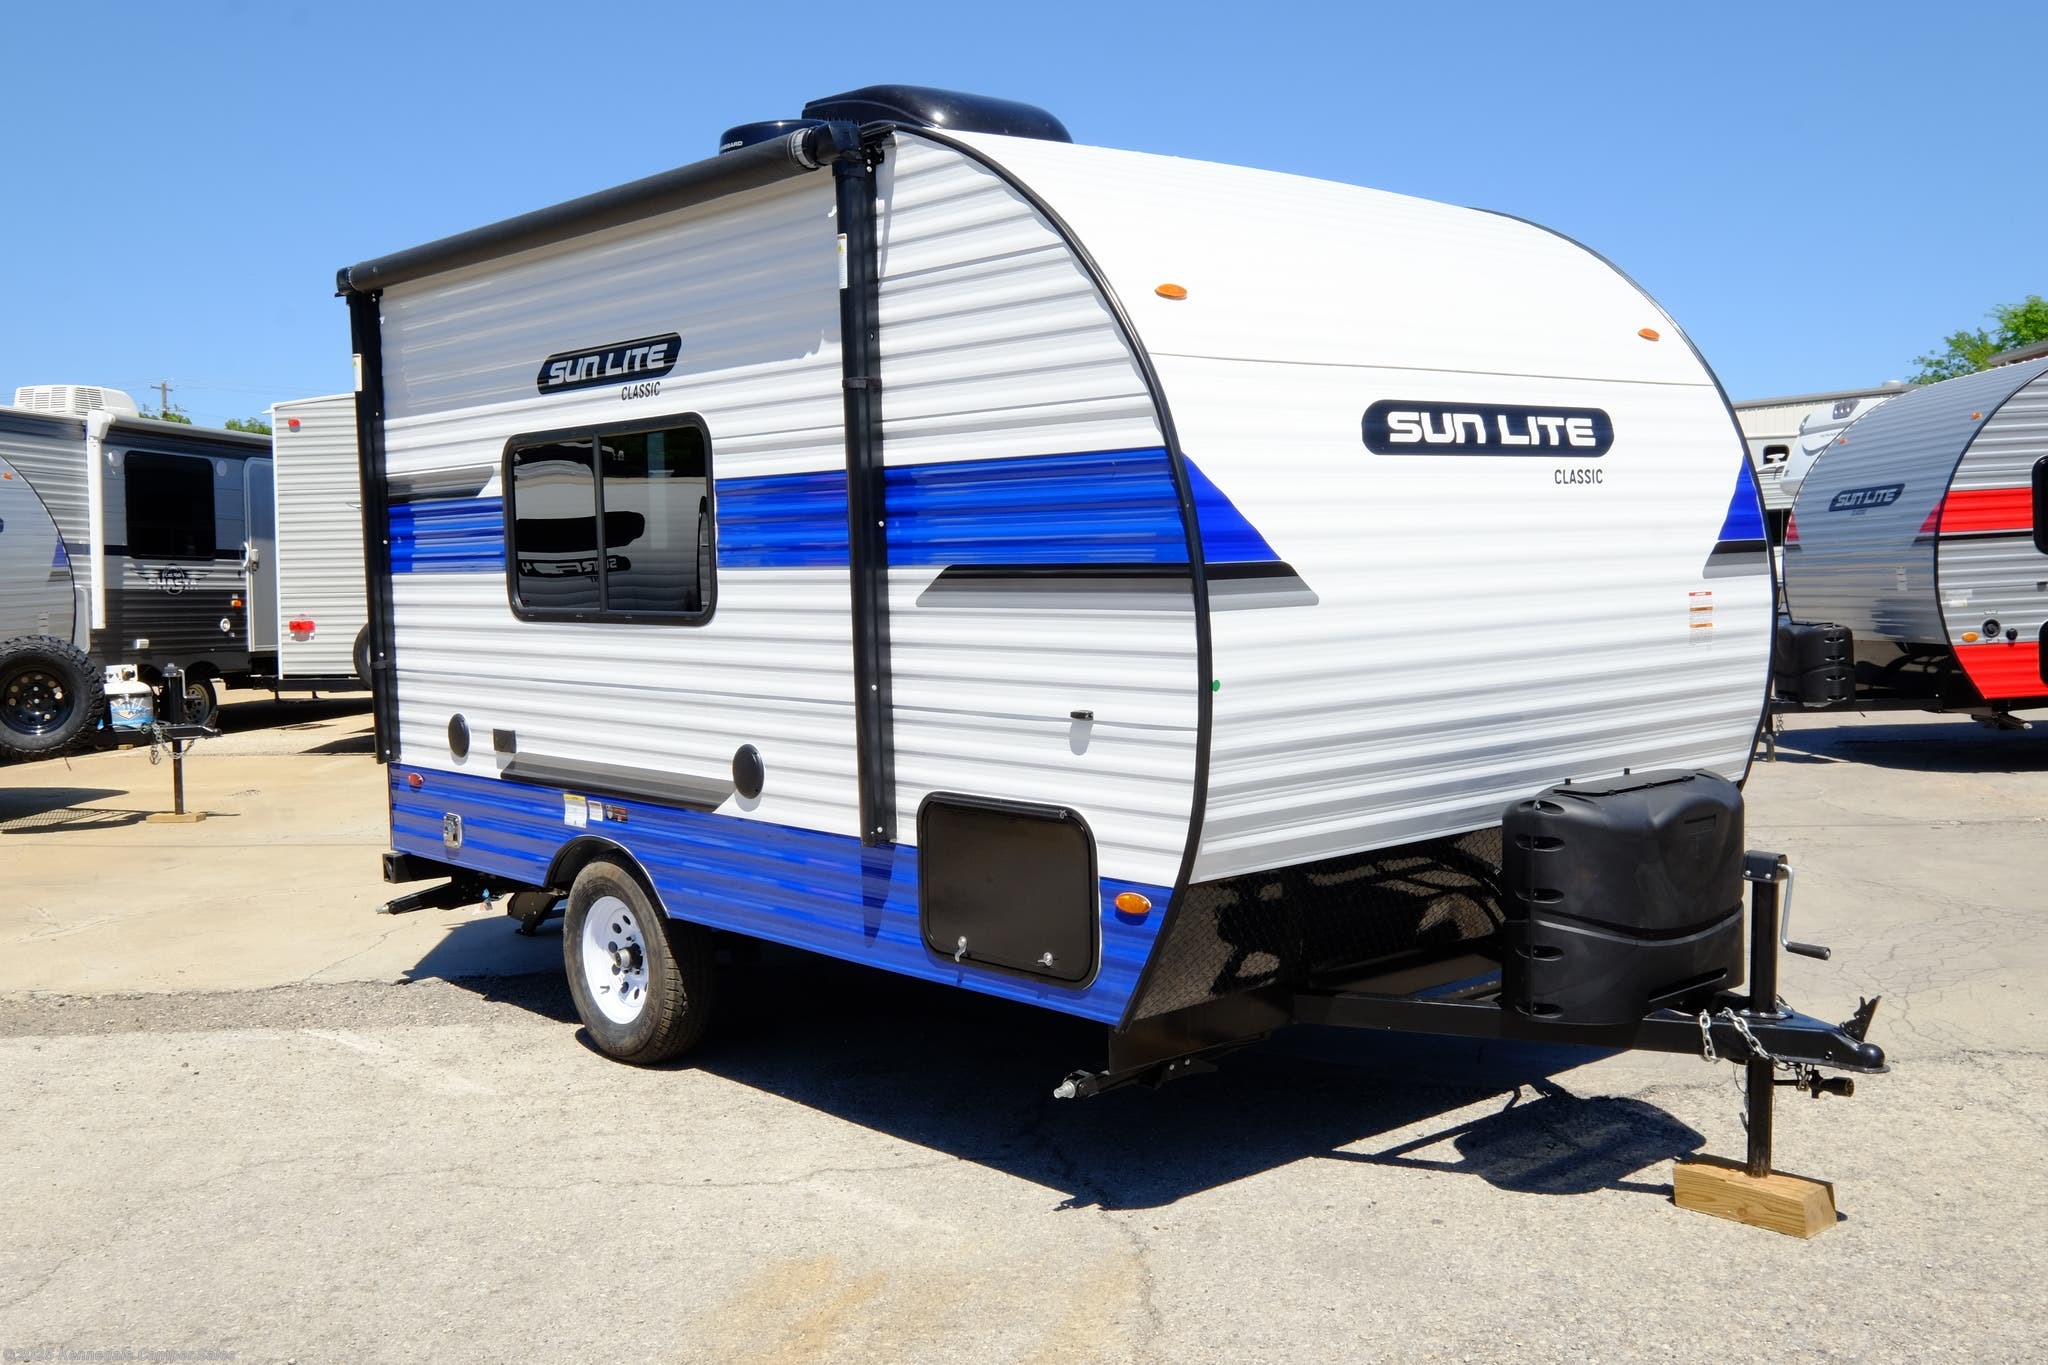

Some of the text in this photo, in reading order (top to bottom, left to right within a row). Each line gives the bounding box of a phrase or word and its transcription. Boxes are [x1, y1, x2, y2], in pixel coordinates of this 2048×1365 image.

[550, 343, 668, 385] SUN LITE
[621, 381, 661, 401] CLASSIC
[1387, 411, 1596, 447] SUN LITE
[1554, 468, 1603, 485] CLASSIC
[1835, 488, 1899, 506] SUN LITE
